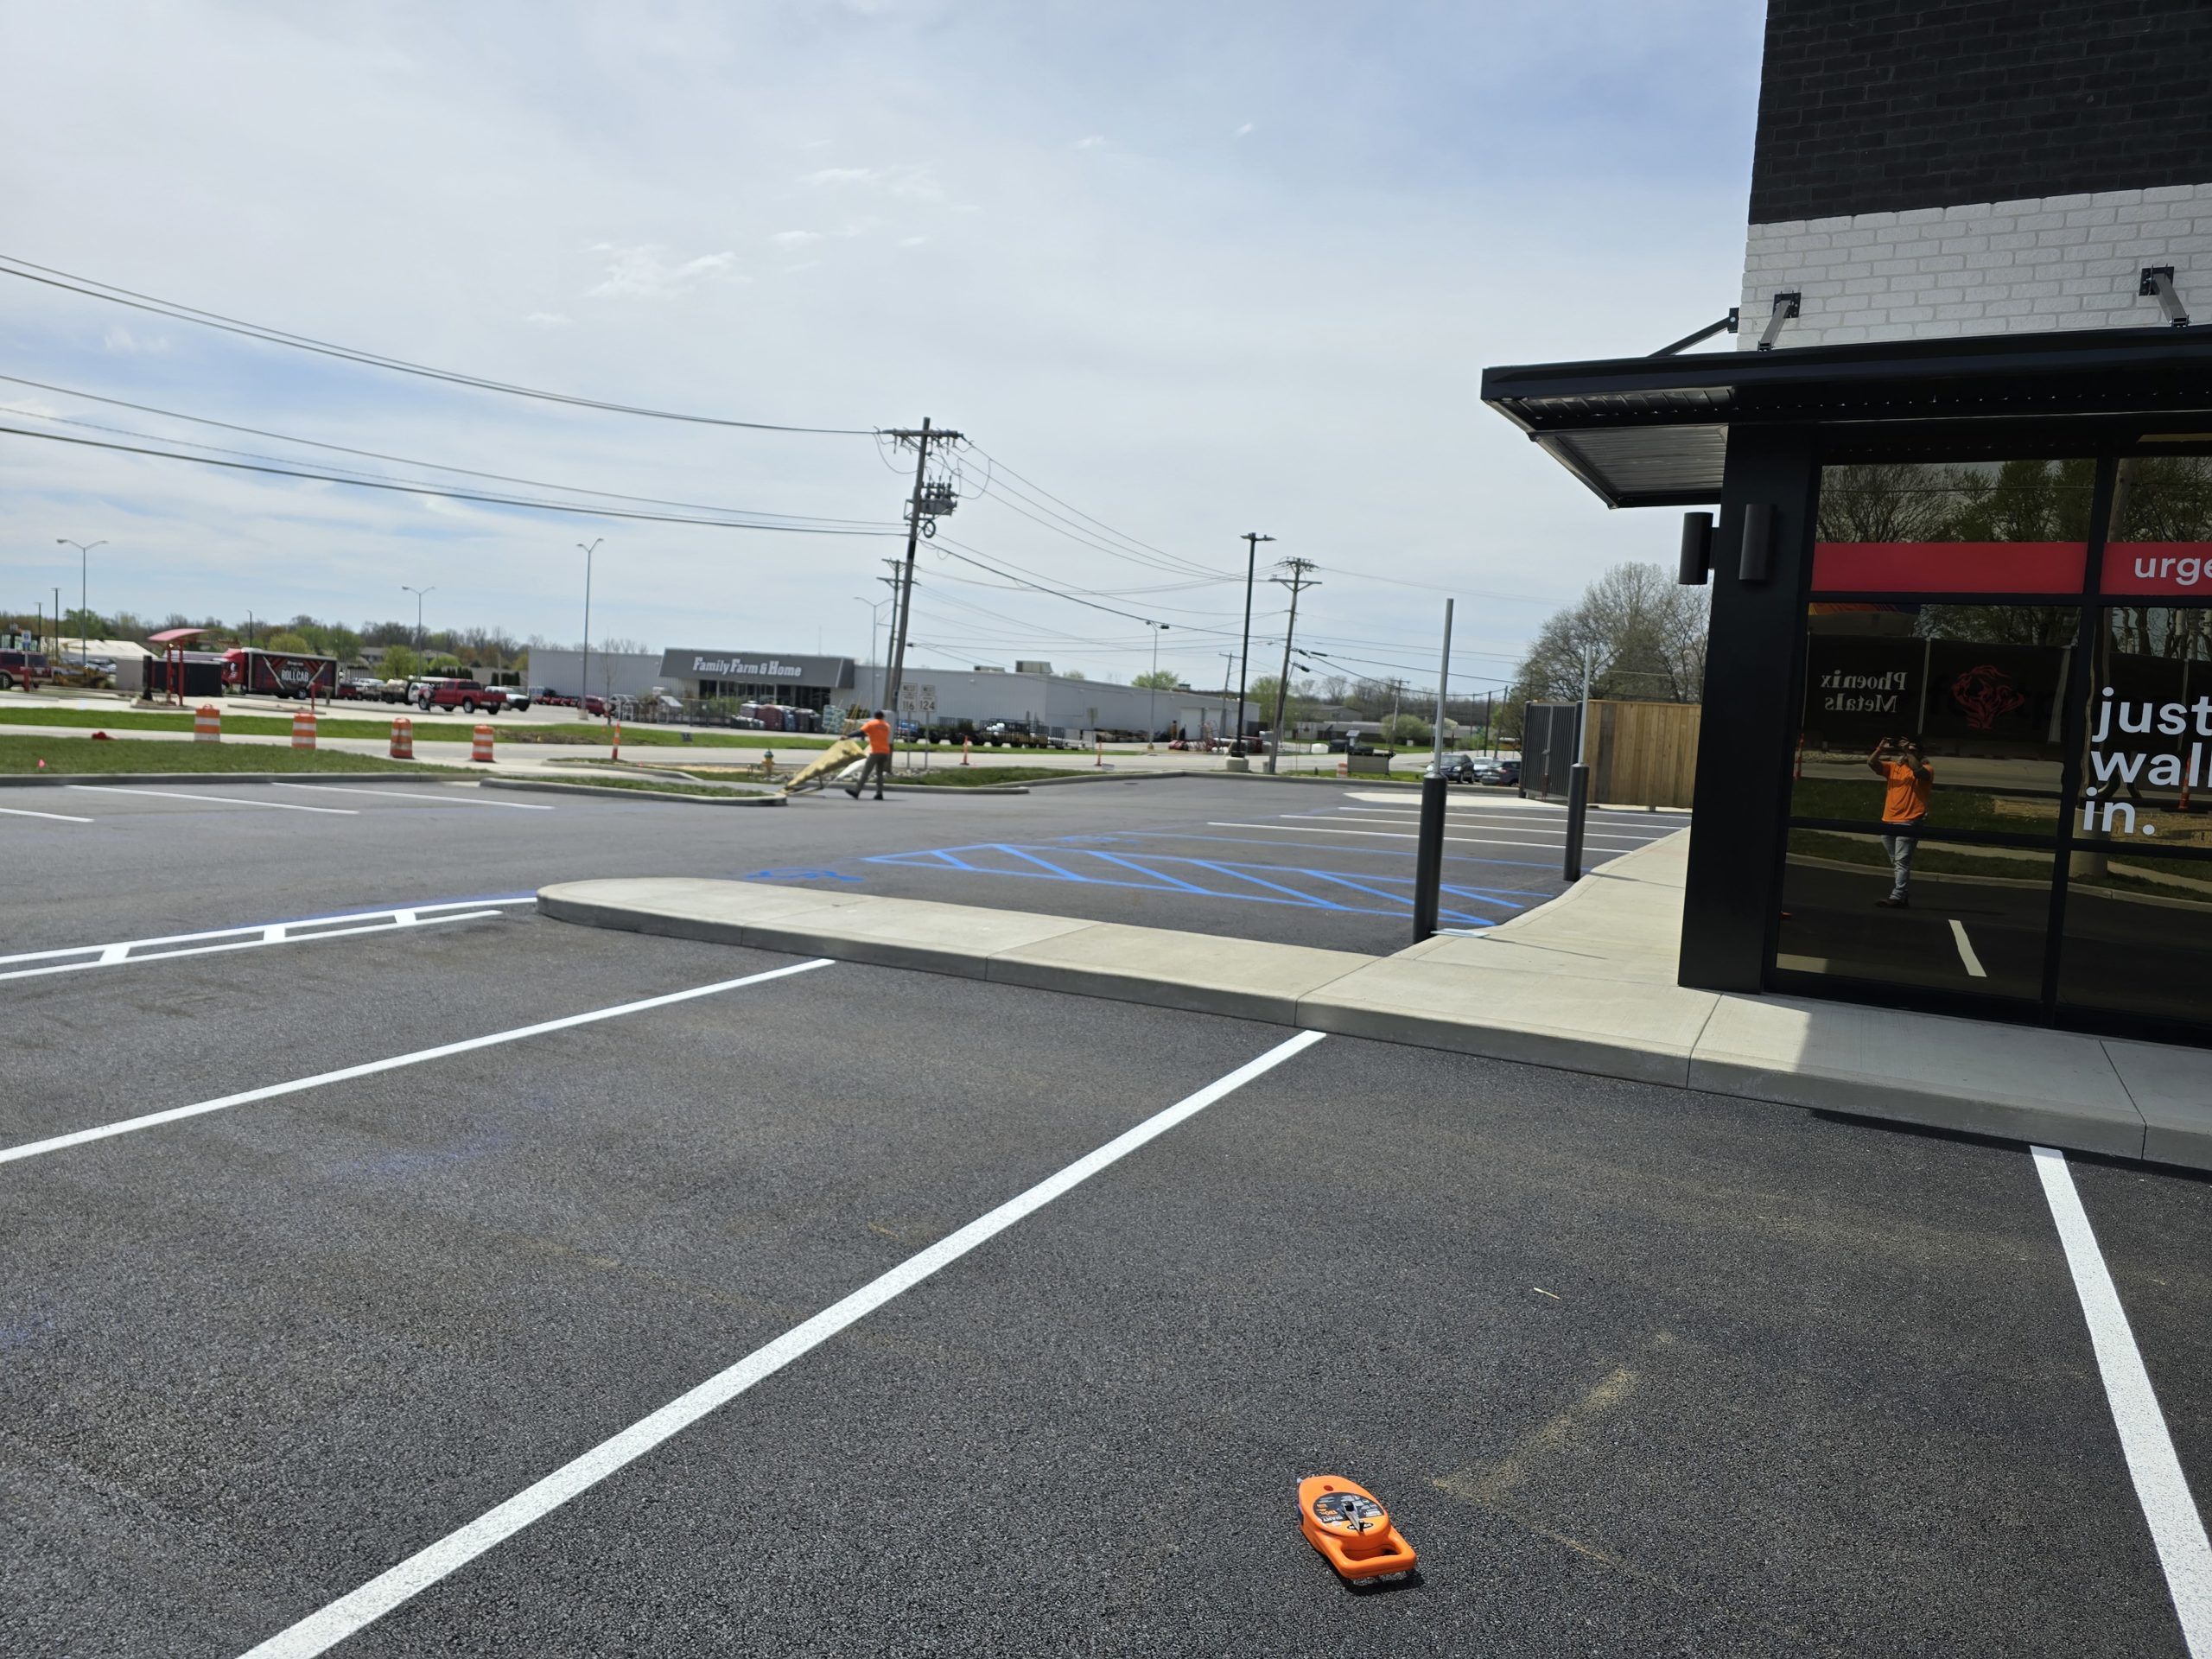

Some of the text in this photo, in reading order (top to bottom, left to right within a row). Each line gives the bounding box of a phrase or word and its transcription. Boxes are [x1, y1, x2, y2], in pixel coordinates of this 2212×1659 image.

[296, 670, 309, 683] CAB
[692, 657, 803, 677] Family Farm & Home
[920, 701, 935, 710] 124
[2091, 686, 2212, 743] just
[2090, 742, 2212, 788] wal
[2082, 786, 2156, 836] in.
